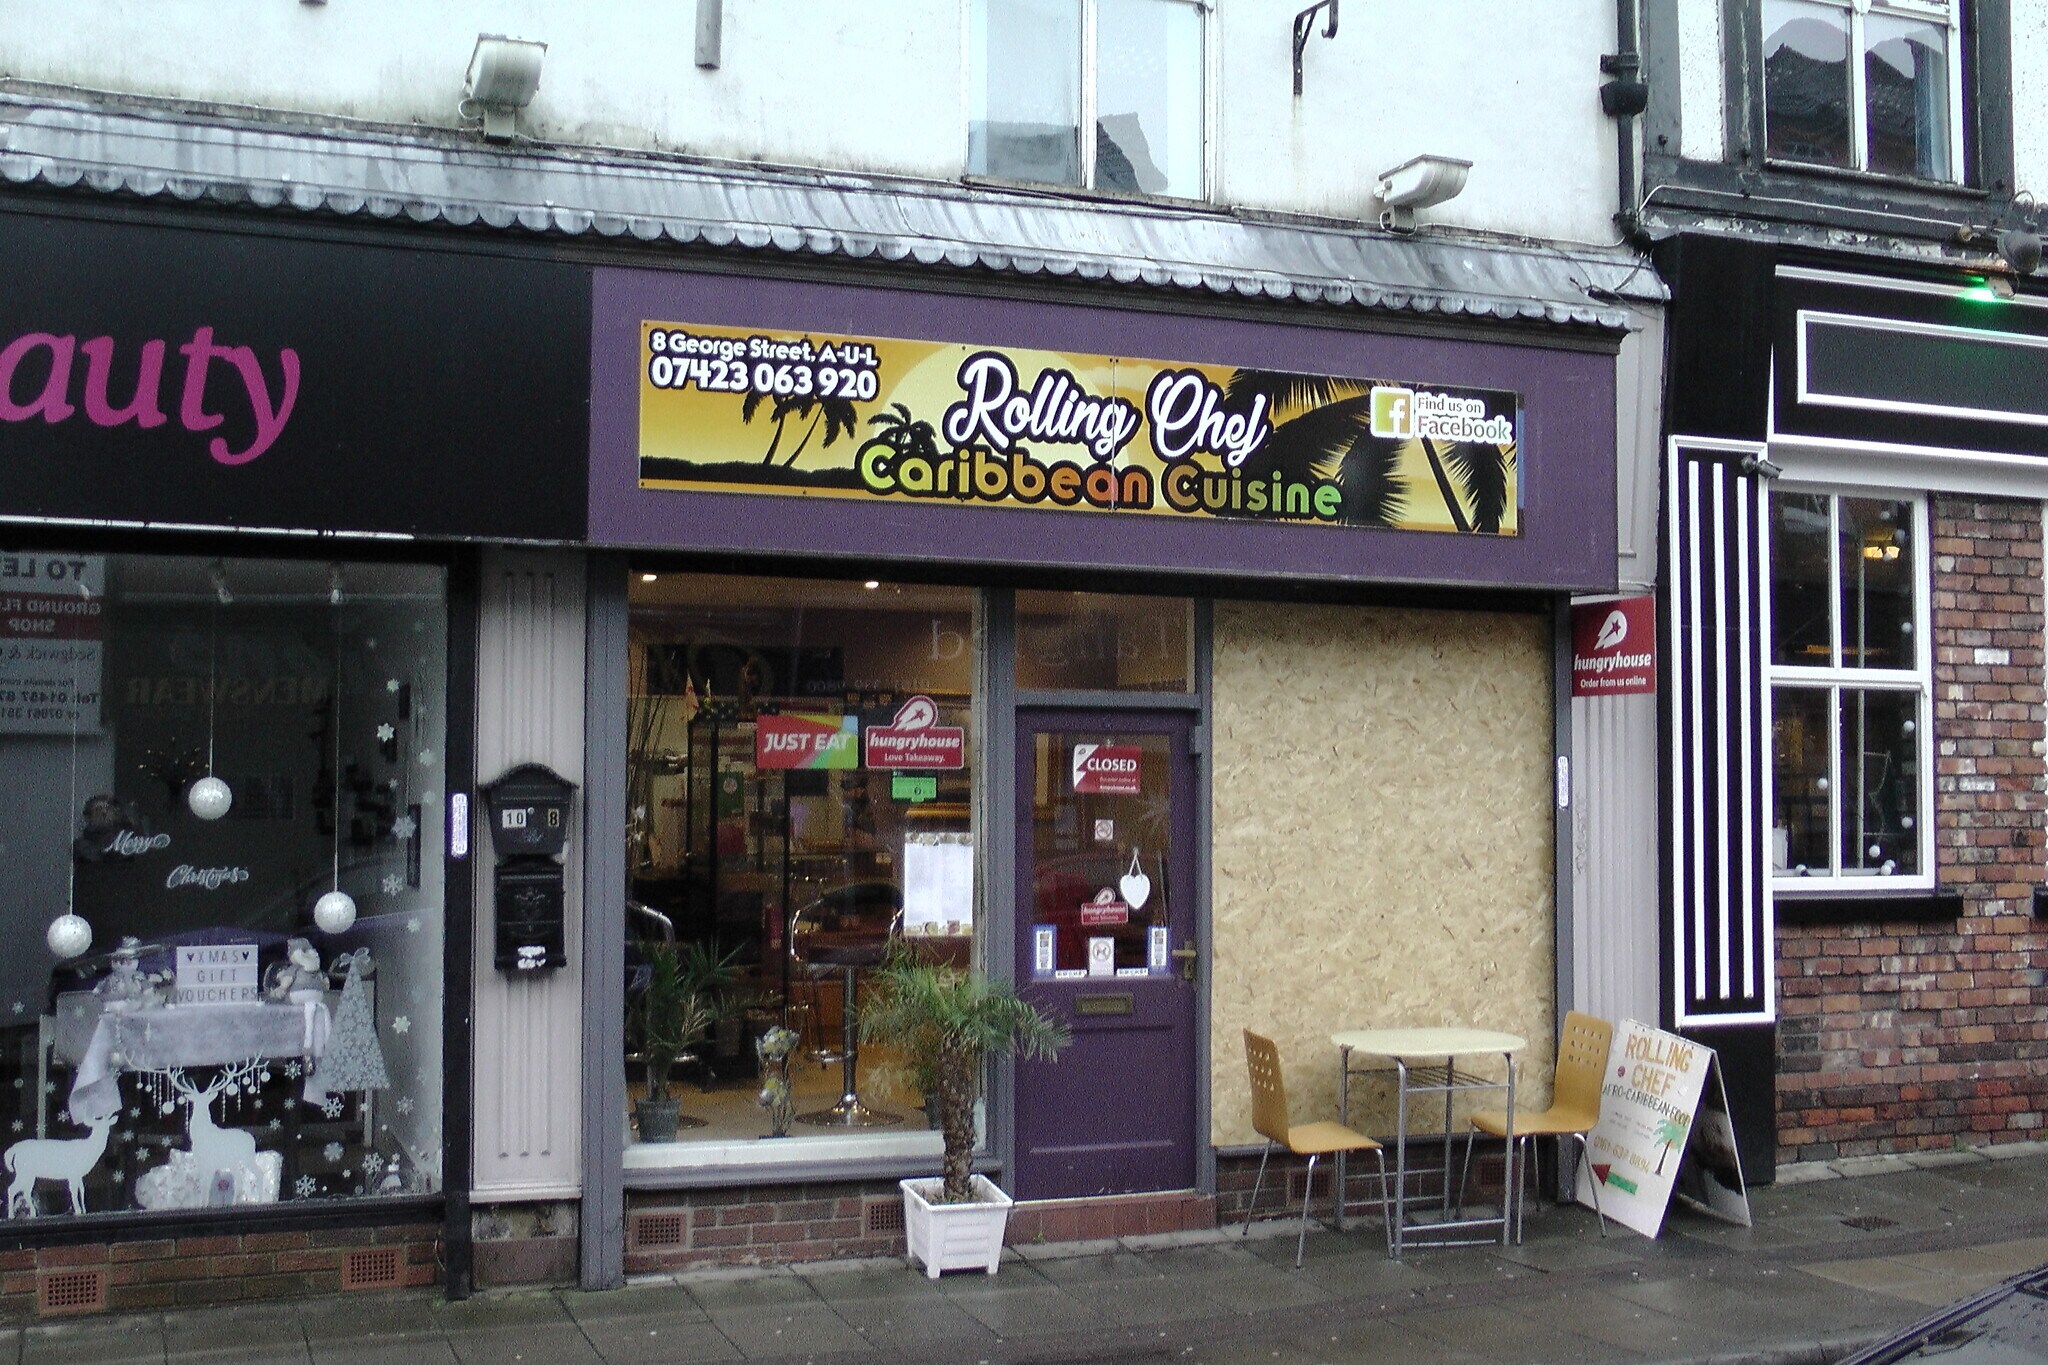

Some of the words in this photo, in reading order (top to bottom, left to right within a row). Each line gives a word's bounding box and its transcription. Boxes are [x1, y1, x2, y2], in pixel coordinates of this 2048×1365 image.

[652, 332, 666, 351] 8
[669, 333, 744, 361] George
[750, 339, 816, 362] Street,
[819, 344, 878, 366] A-U-L
[652, 355, 749, 391] 07423
[754, 362, 813, 395] 063
[818, 367, 877, 399] 920
[949, 356, 1137, 451] Rolling
[1151, 373, 1268, 467] Chef
[1418, 397, 1445, 411] Find
[1448, 402, 1463, 412] us
[1466, 403, 1481, 414] on
[1418, 415, 1508, 440] Facebook
[860, 443, 1148, 505] Caribbean
[1167, 461, 1342, 516] Cuisine
[1574, 651, 1652, 673] hungryhouse
[1580, 678, 1599, 689] Order
[1600, 677, 1616, 688] from
[1617, 679, 1625, 687] us
[1625, 676, 1647, 687] online
[764, 733, 810, 753] JUST
[815, 733, 851, 751] EAT
[870, 732, 960, 750] hungryhouse
[884, 753, 903, 762] Love
[1087, 758, 1137, 771] CLOSED
[506, 813, 524, 825] 10
[550, 812, 558, 826] 8
[166, 864, 249, 889] Christmas
[198, 950, 239, 963] XMAS
[178, 986, 258, 1002] VOUCHERS
[1625, 1033, 1693, 1073] ROLLING
[1631, 1063, 1676, 1097] CHEF
